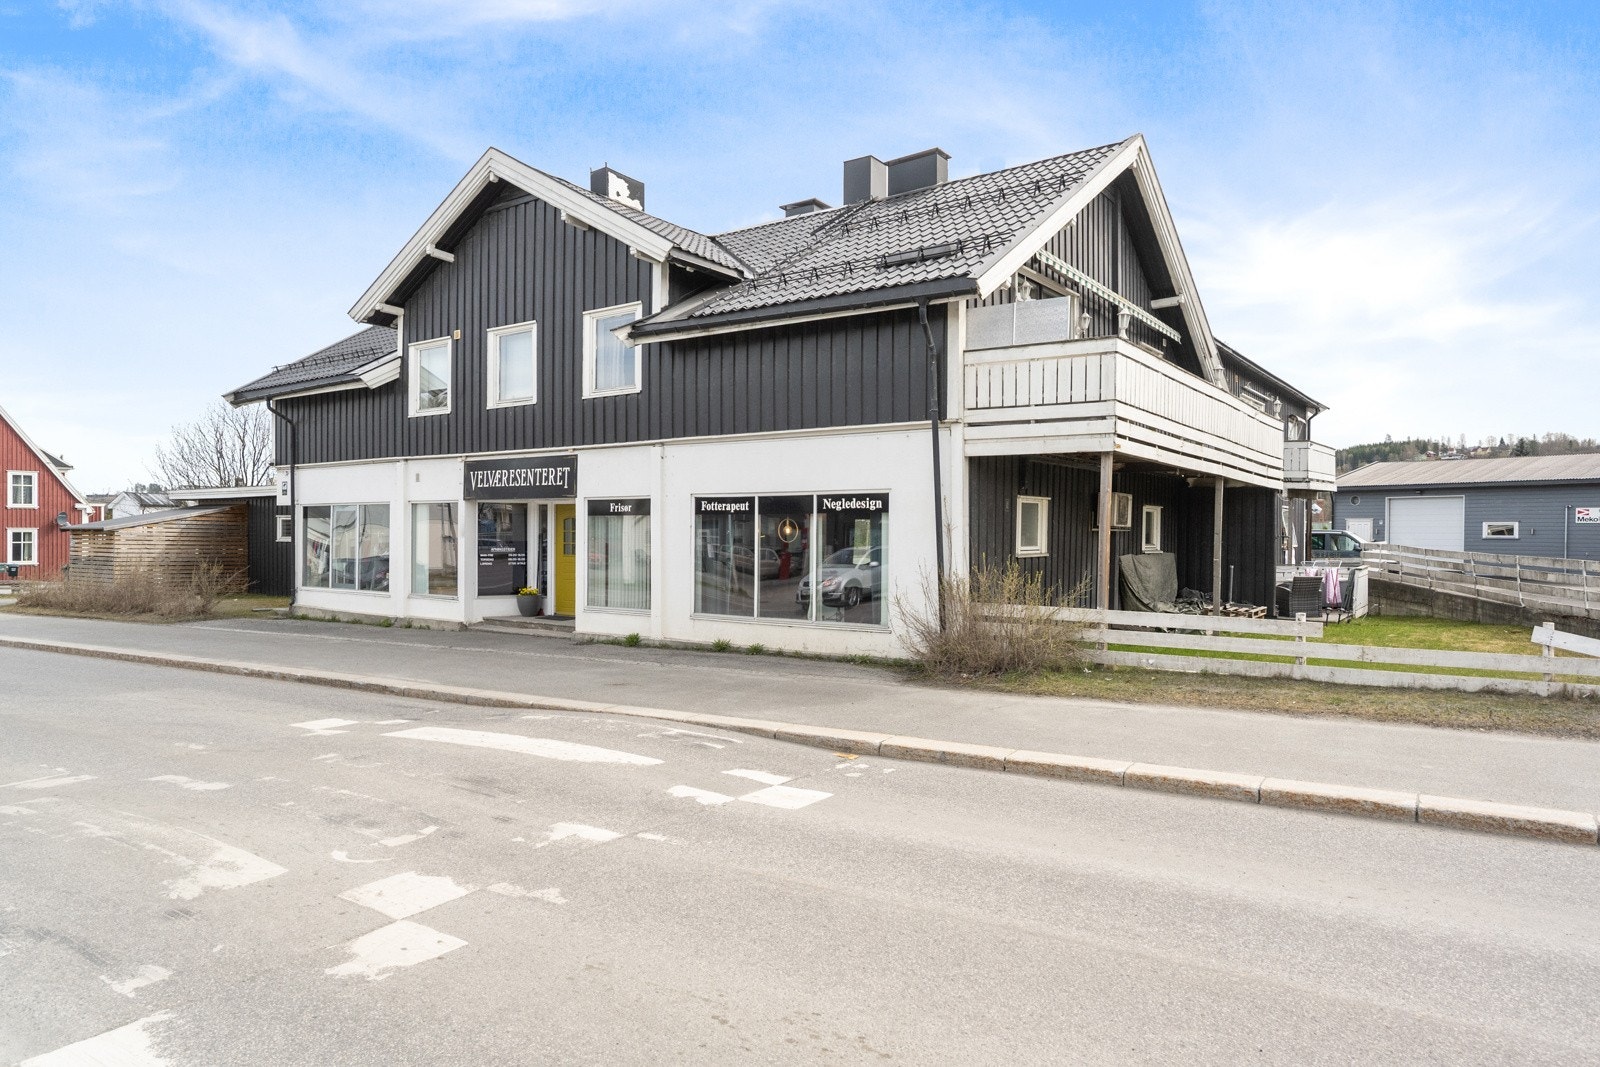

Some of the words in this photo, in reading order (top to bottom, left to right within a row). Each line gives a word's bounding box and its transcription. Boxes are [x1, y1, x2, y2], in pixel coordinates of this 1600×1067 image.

[470, 467, 570, 491] VELVÆRESENTERET
[701, 500, 749, 512] Fotterapeut
[823, 497, 882, 511] Negledesign
